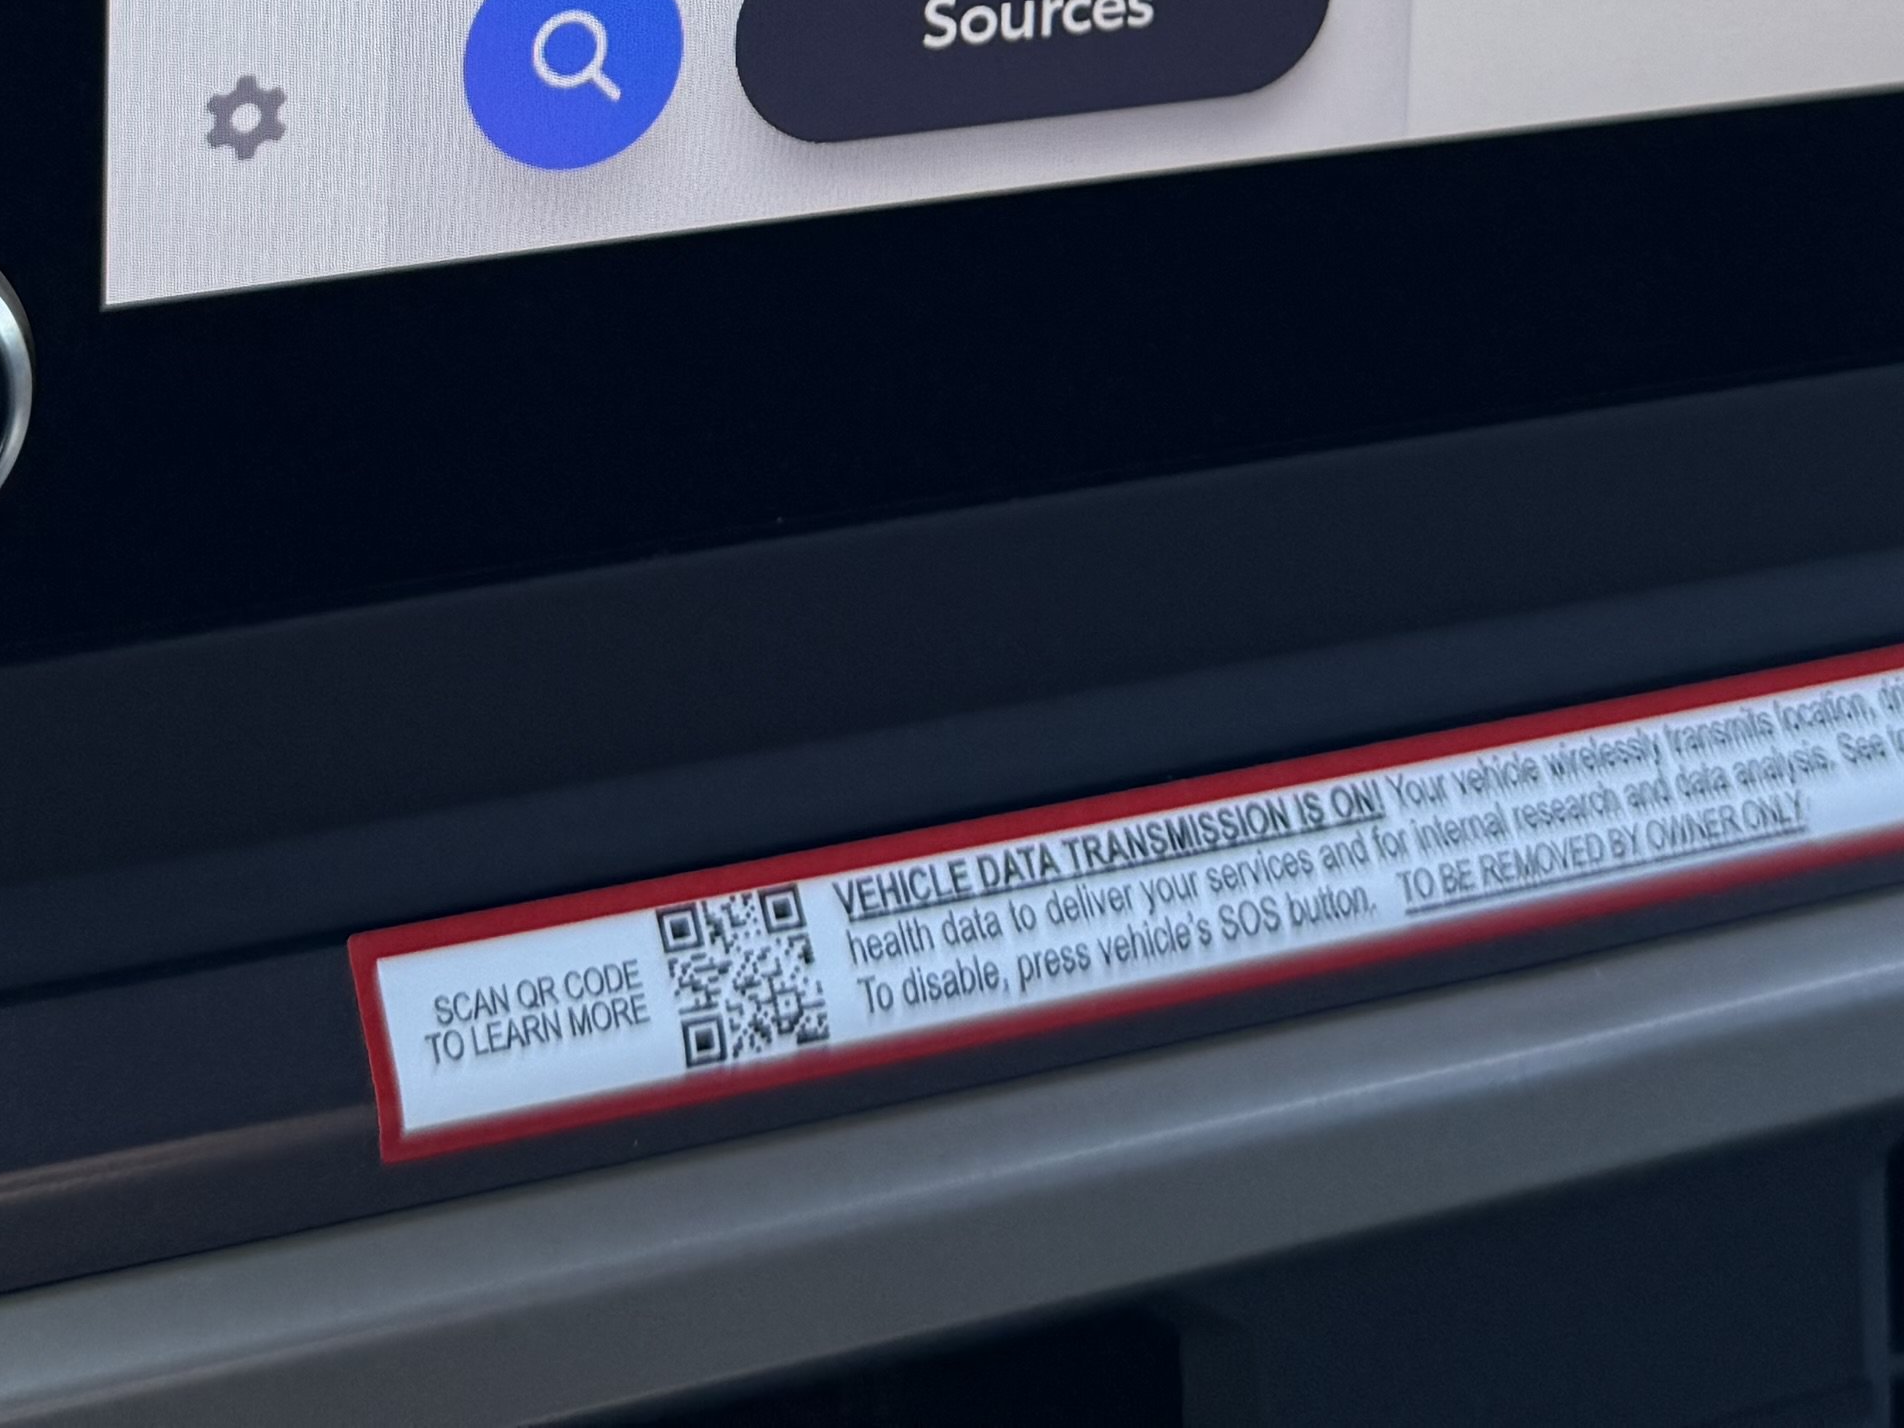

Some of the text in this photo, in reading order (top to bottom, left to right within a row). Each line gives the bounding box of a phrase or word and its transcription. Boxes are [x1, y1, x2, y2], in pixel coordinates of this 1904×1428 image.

[833, 862, 971, 918] VEHICLE
[977, 843, 1060, 890] DATA
[1061, 804, 1290, 874] TRANSMISSION
[1296, 791, 1324, 824] IS
[1330, 778, 1385, 819] ON!
[1391, 774, 1450, 810] Your
[1455, 755, 1541, 796] vehicle
[1544, 729, 1664, 776] wirelessly
[1665, 708, 1776, 748] transmits
[846, 912, 935, 966] health
[942, 902, 1002, 947] data
[1009, 901, 1037, 931] to
[1045, 883, 1133, 927] deliver
[1140, 872, 1199, 916] your
[1207, 851, 1313, 896] services
[1320, 831, 1368, 873] and
[1372, 824, 1409, 860] for
[1414, 810, 1508, 850] internal
[1513, 788, 1621, 828] research
[1624, 768, 1674, 808] and
[1677, 759, 1729, 797] data
[1736, 740, 1835, 786] analysis.
[1836, 730, 1887, 764] See
[857, 790, 1809, 1016] To disable, press vehicle's SOS button. TO BE REMOVED BY OWNER ONLY
[425, 993, 650, 1065] TO LEARN MORE
[433, 959, 644, 1026] SCAN QR CODE
